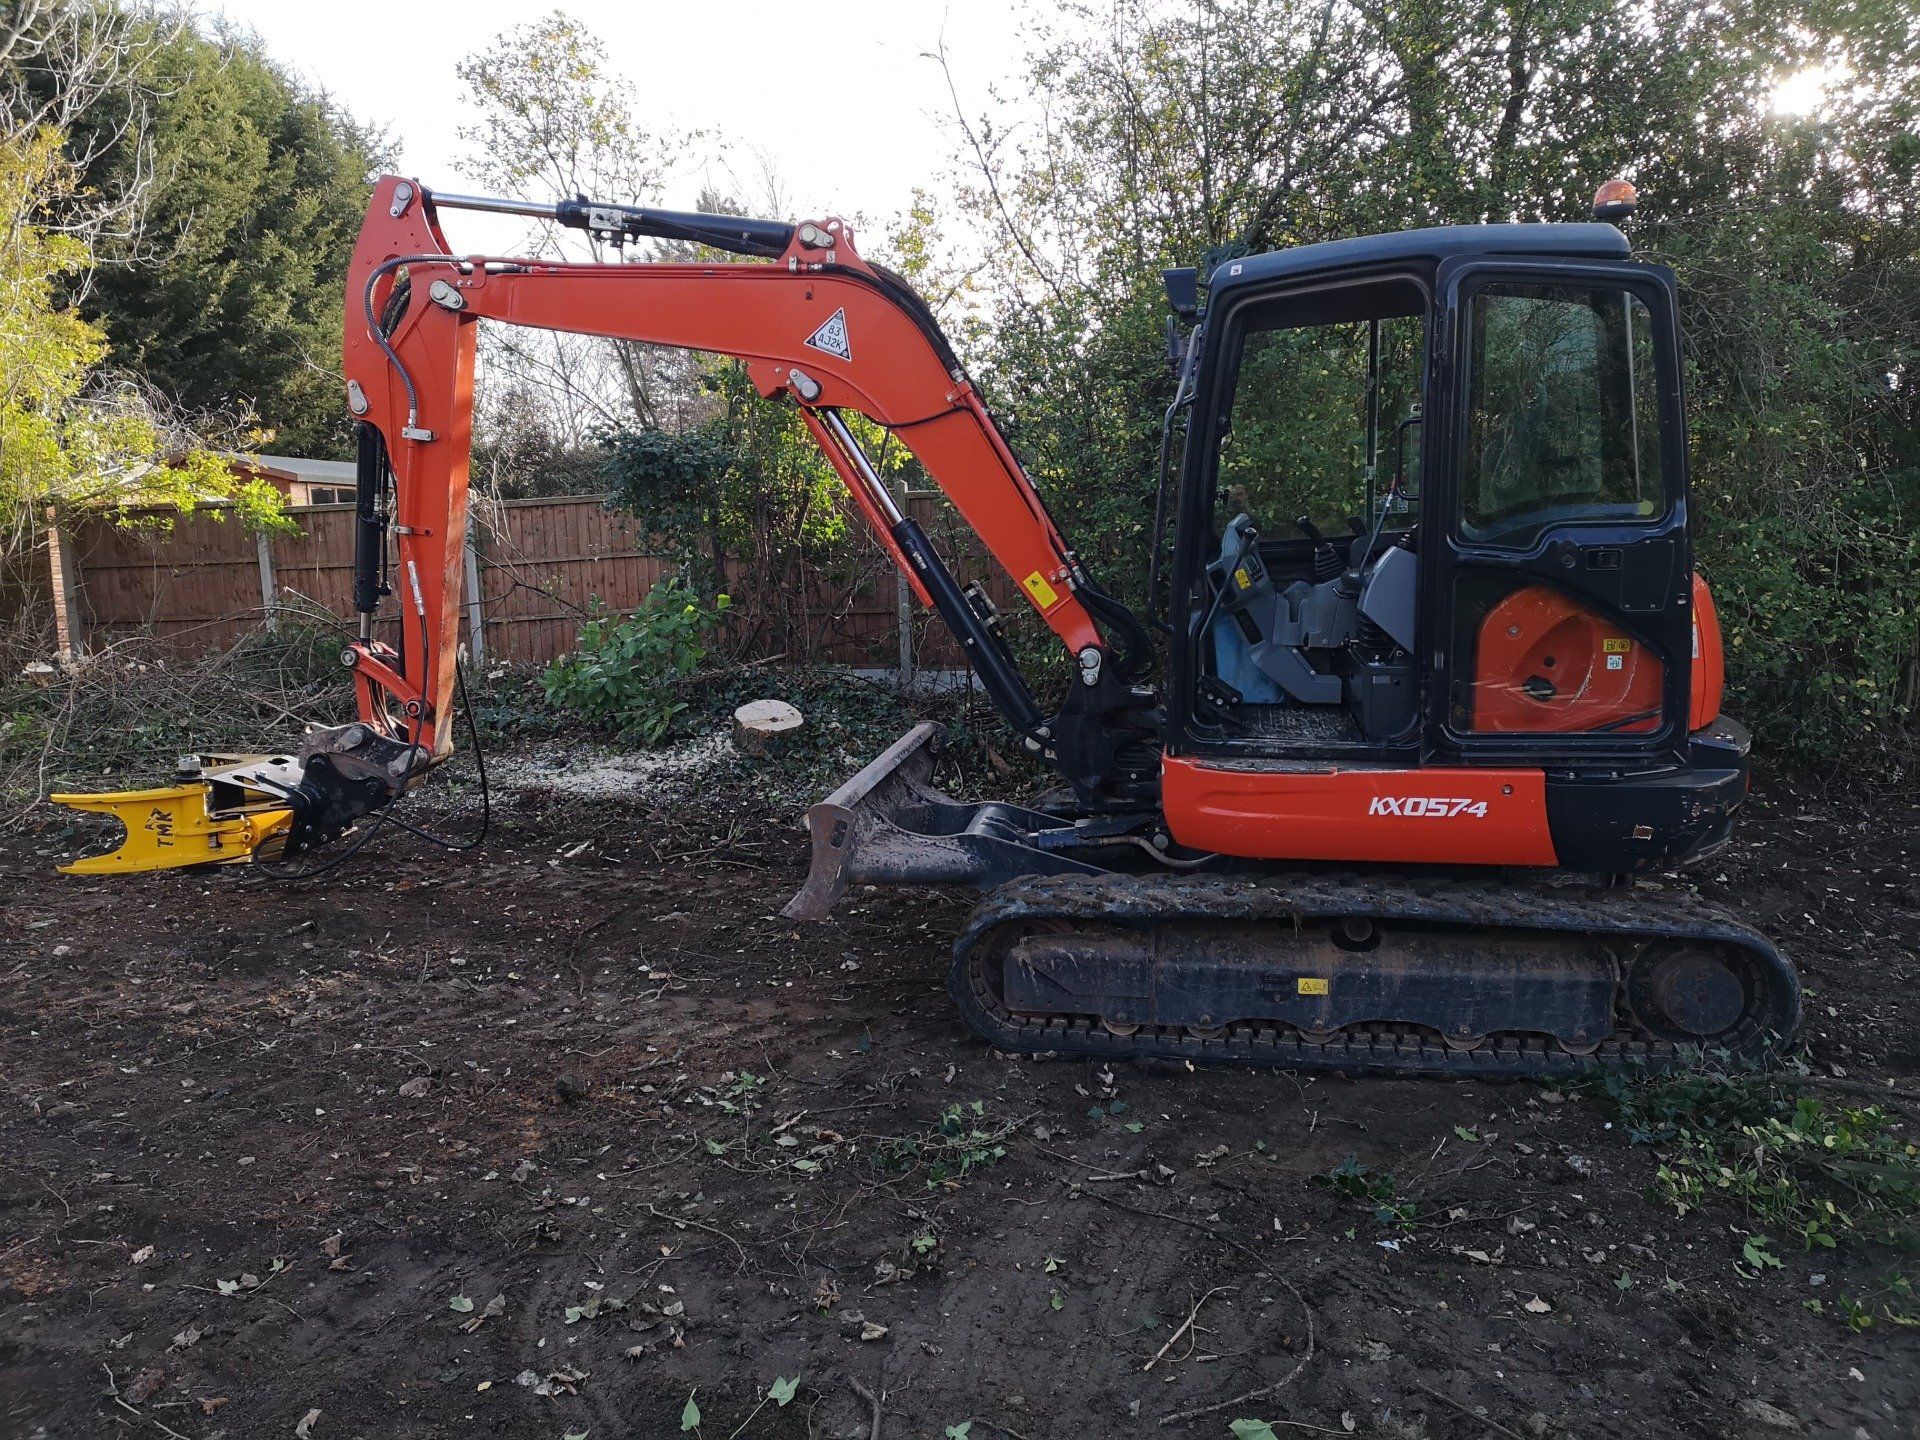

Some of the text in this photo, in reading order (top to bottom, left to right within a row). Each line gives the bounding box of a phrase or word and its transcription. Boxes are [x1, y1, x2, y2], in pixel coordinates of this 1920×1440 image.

[828, 324, 842, 337] 83
[1368, 796, 1488, 818] KX057-4
[156, 811, 174, 848] TMK
